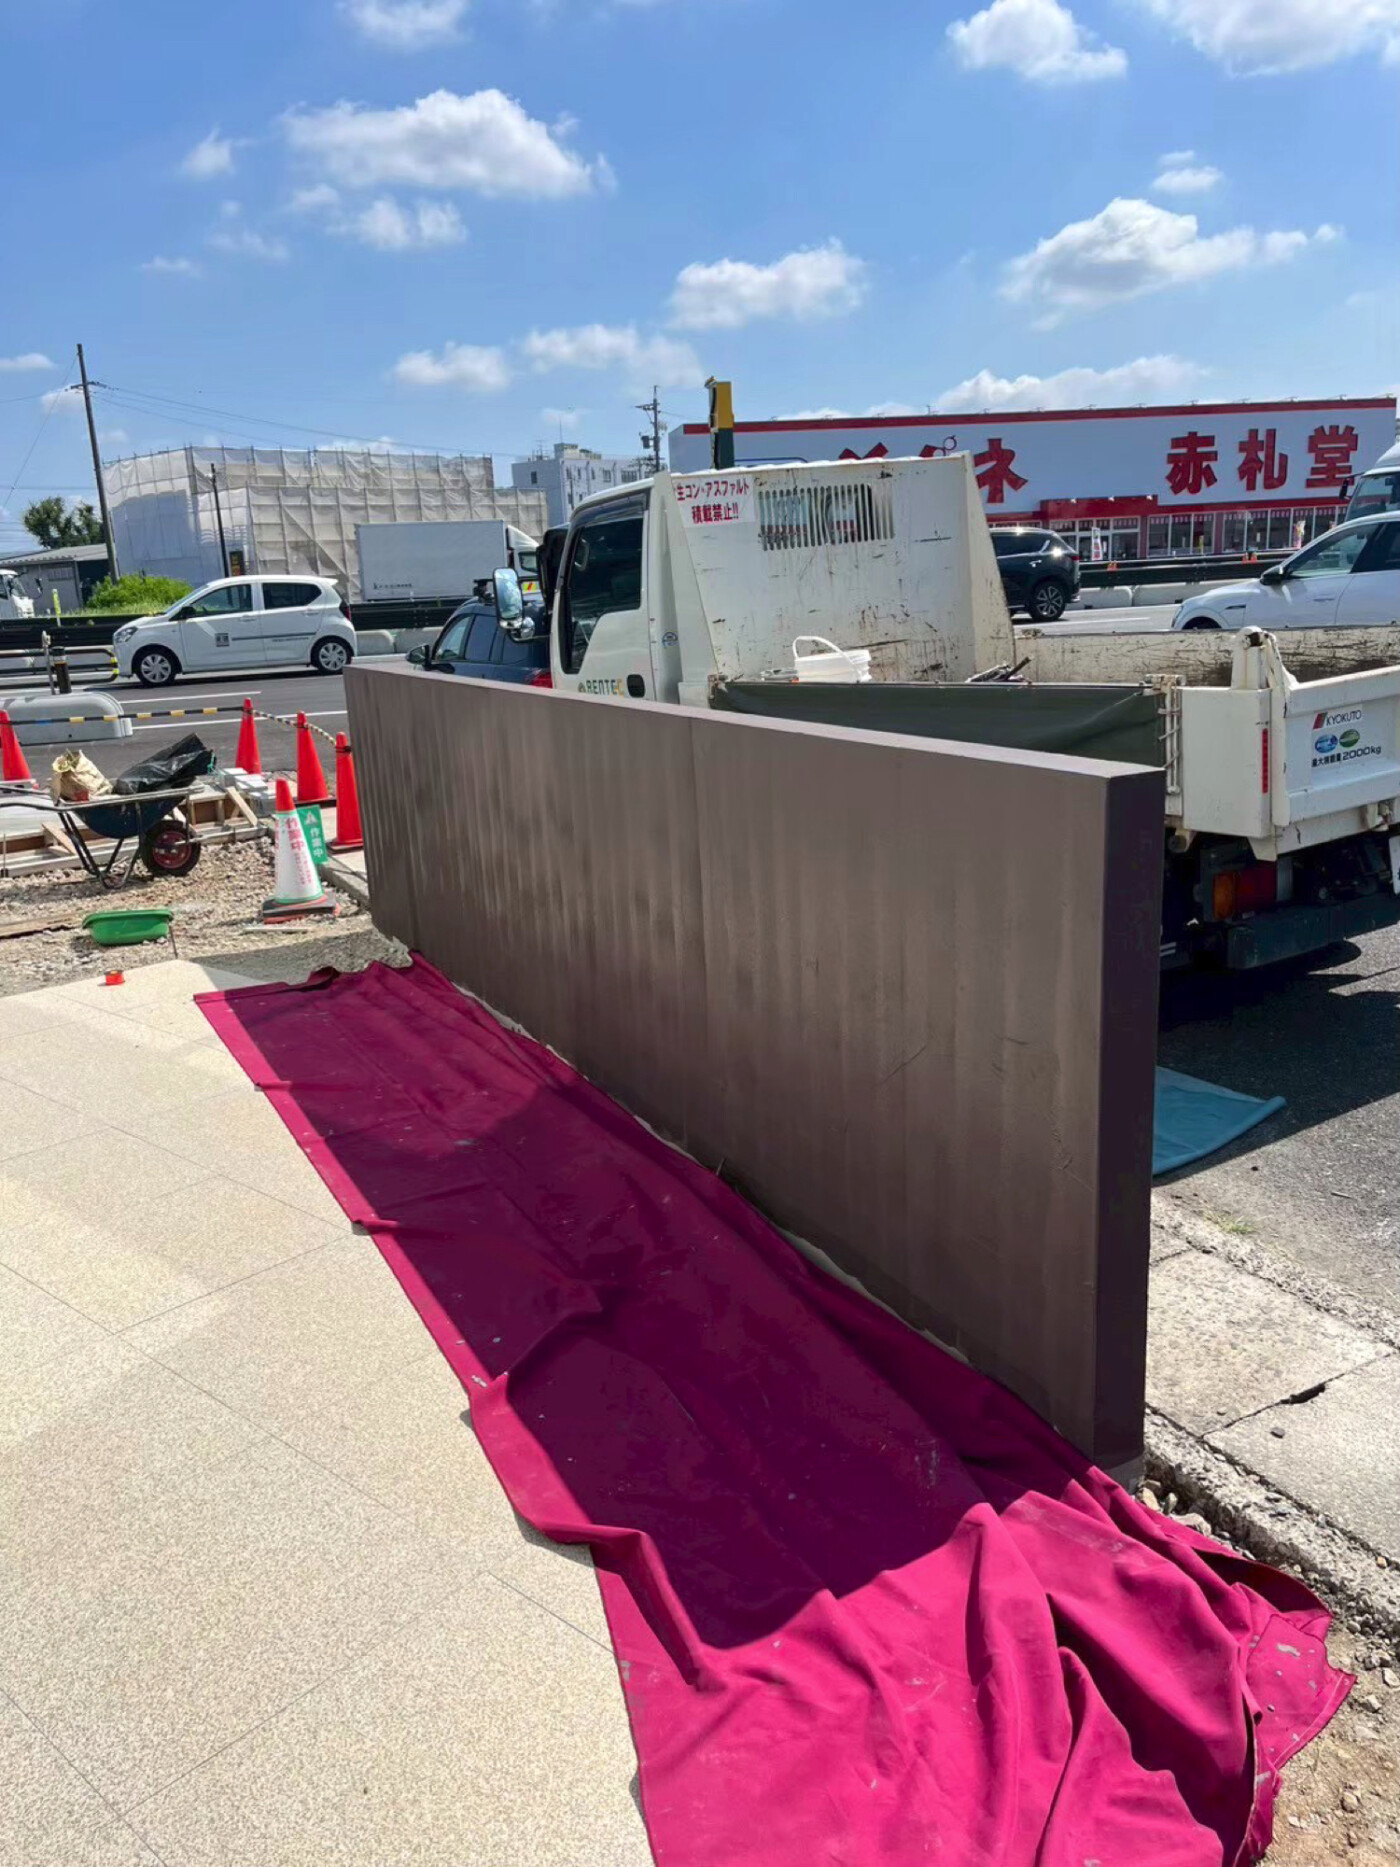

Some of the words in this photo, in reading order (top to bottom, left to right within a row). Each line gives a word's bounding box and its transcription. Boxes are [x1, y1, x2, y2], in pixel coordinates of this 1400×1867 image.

[1166, 424, 1358, 494] 赤札堂
[1326, 710, 1362, 726] KYOKUTO
